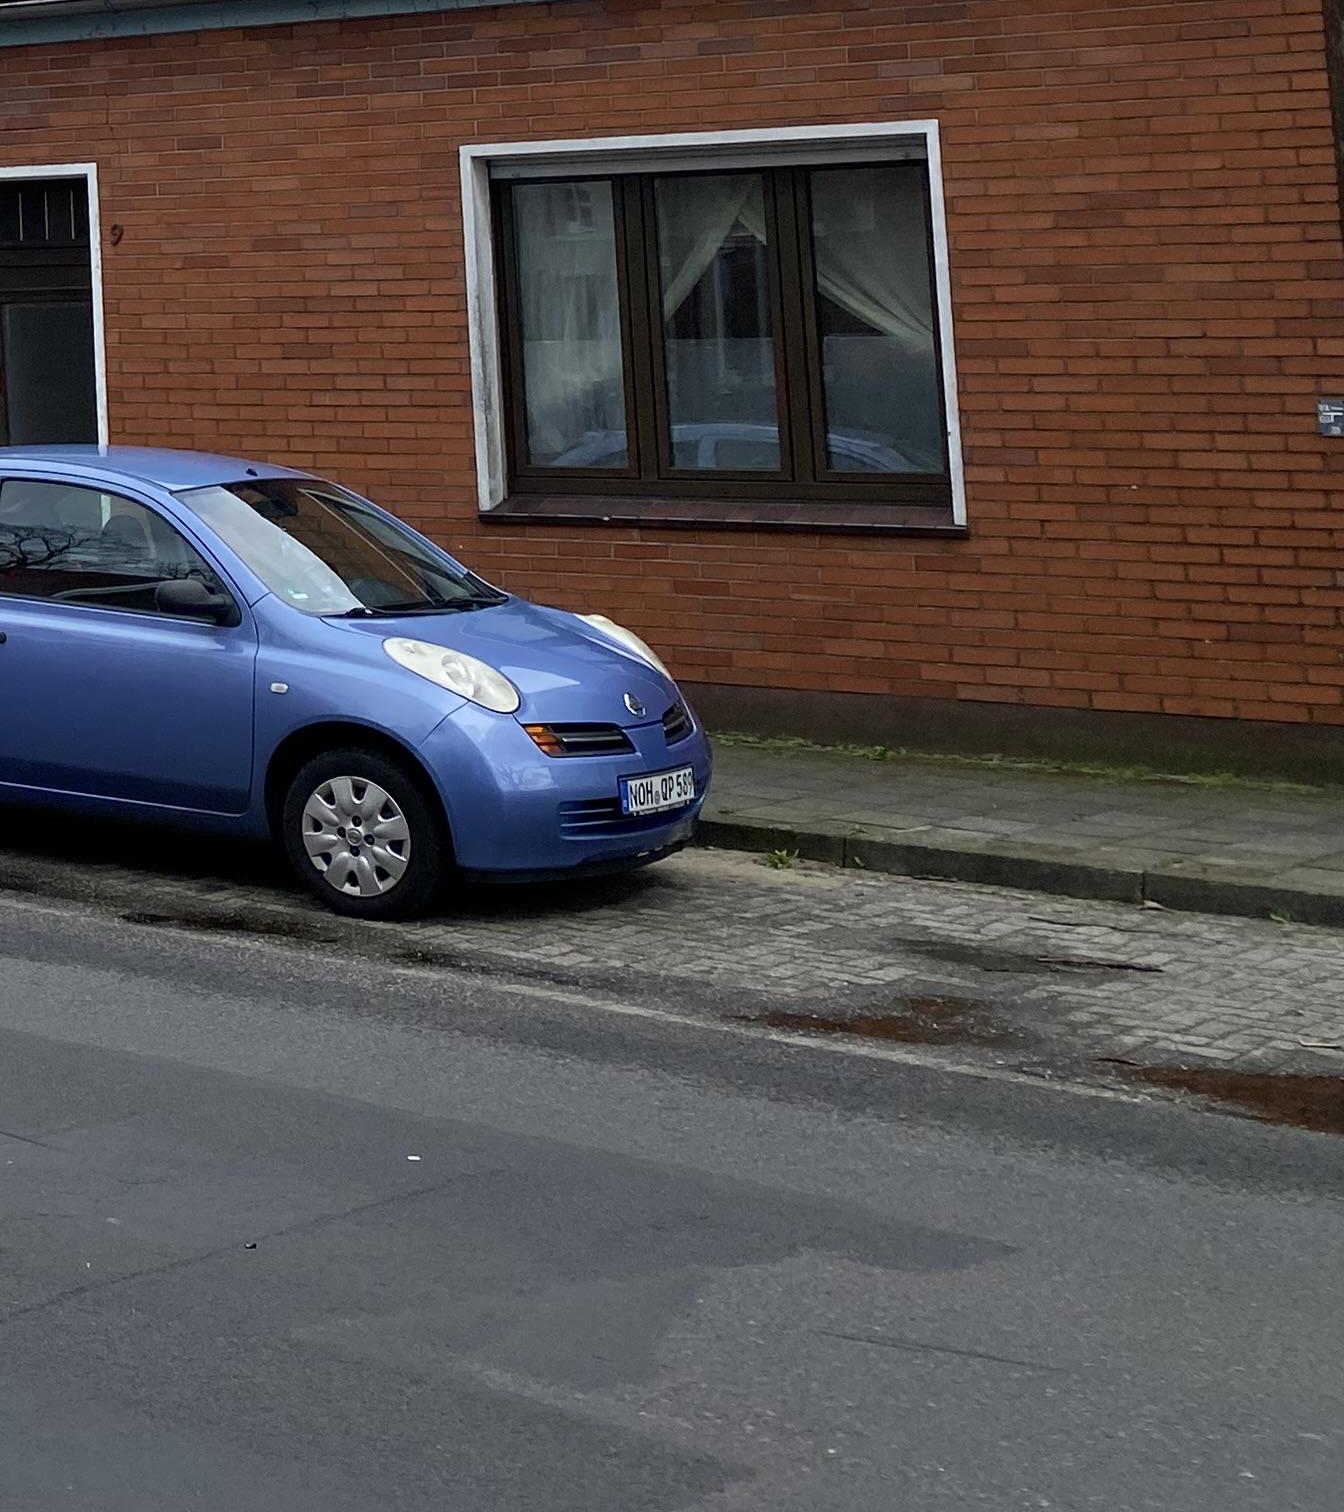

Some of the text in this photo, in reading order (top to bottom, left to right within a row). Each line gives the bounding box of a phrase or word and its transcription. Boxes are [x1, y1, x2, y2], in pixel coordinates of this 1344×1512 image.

[111, 224, 123, 246] 9
[630, 780, 653, 808] NOH
[661, 776, 674, 801] QP
[676, 771, 692, 797] 589
